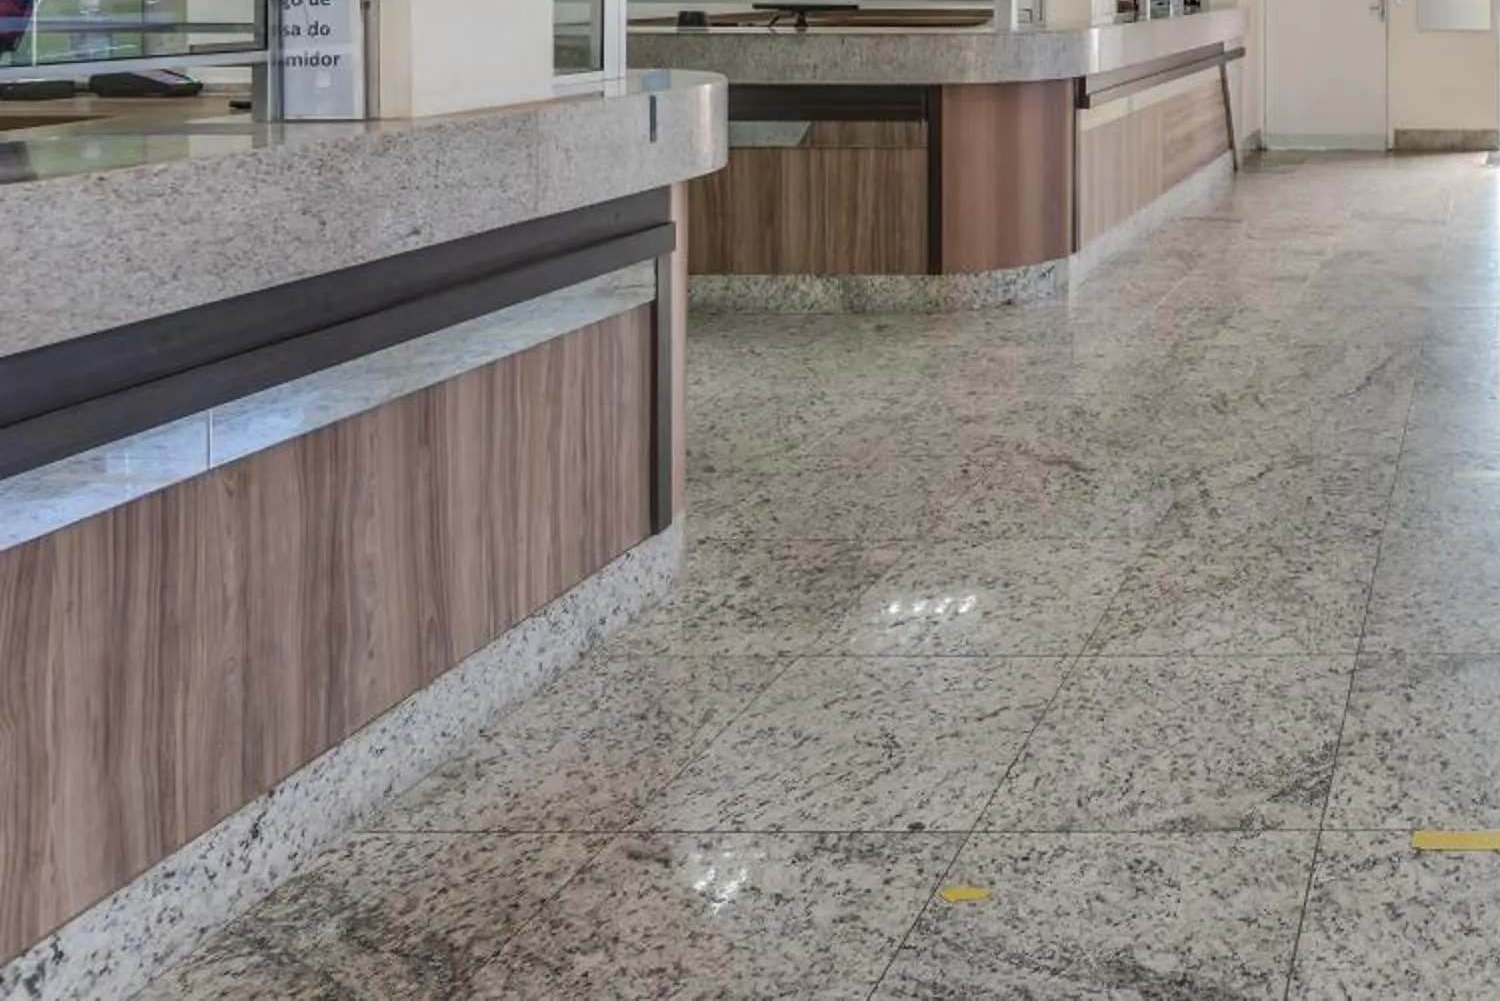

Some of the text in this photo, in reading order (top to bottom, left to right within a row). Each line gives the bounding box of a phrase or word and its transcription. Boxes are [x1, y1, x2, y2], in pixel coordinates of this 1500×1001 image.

[280, 20, 331, 38] sa do
[282, 50, 341, 68] midor
